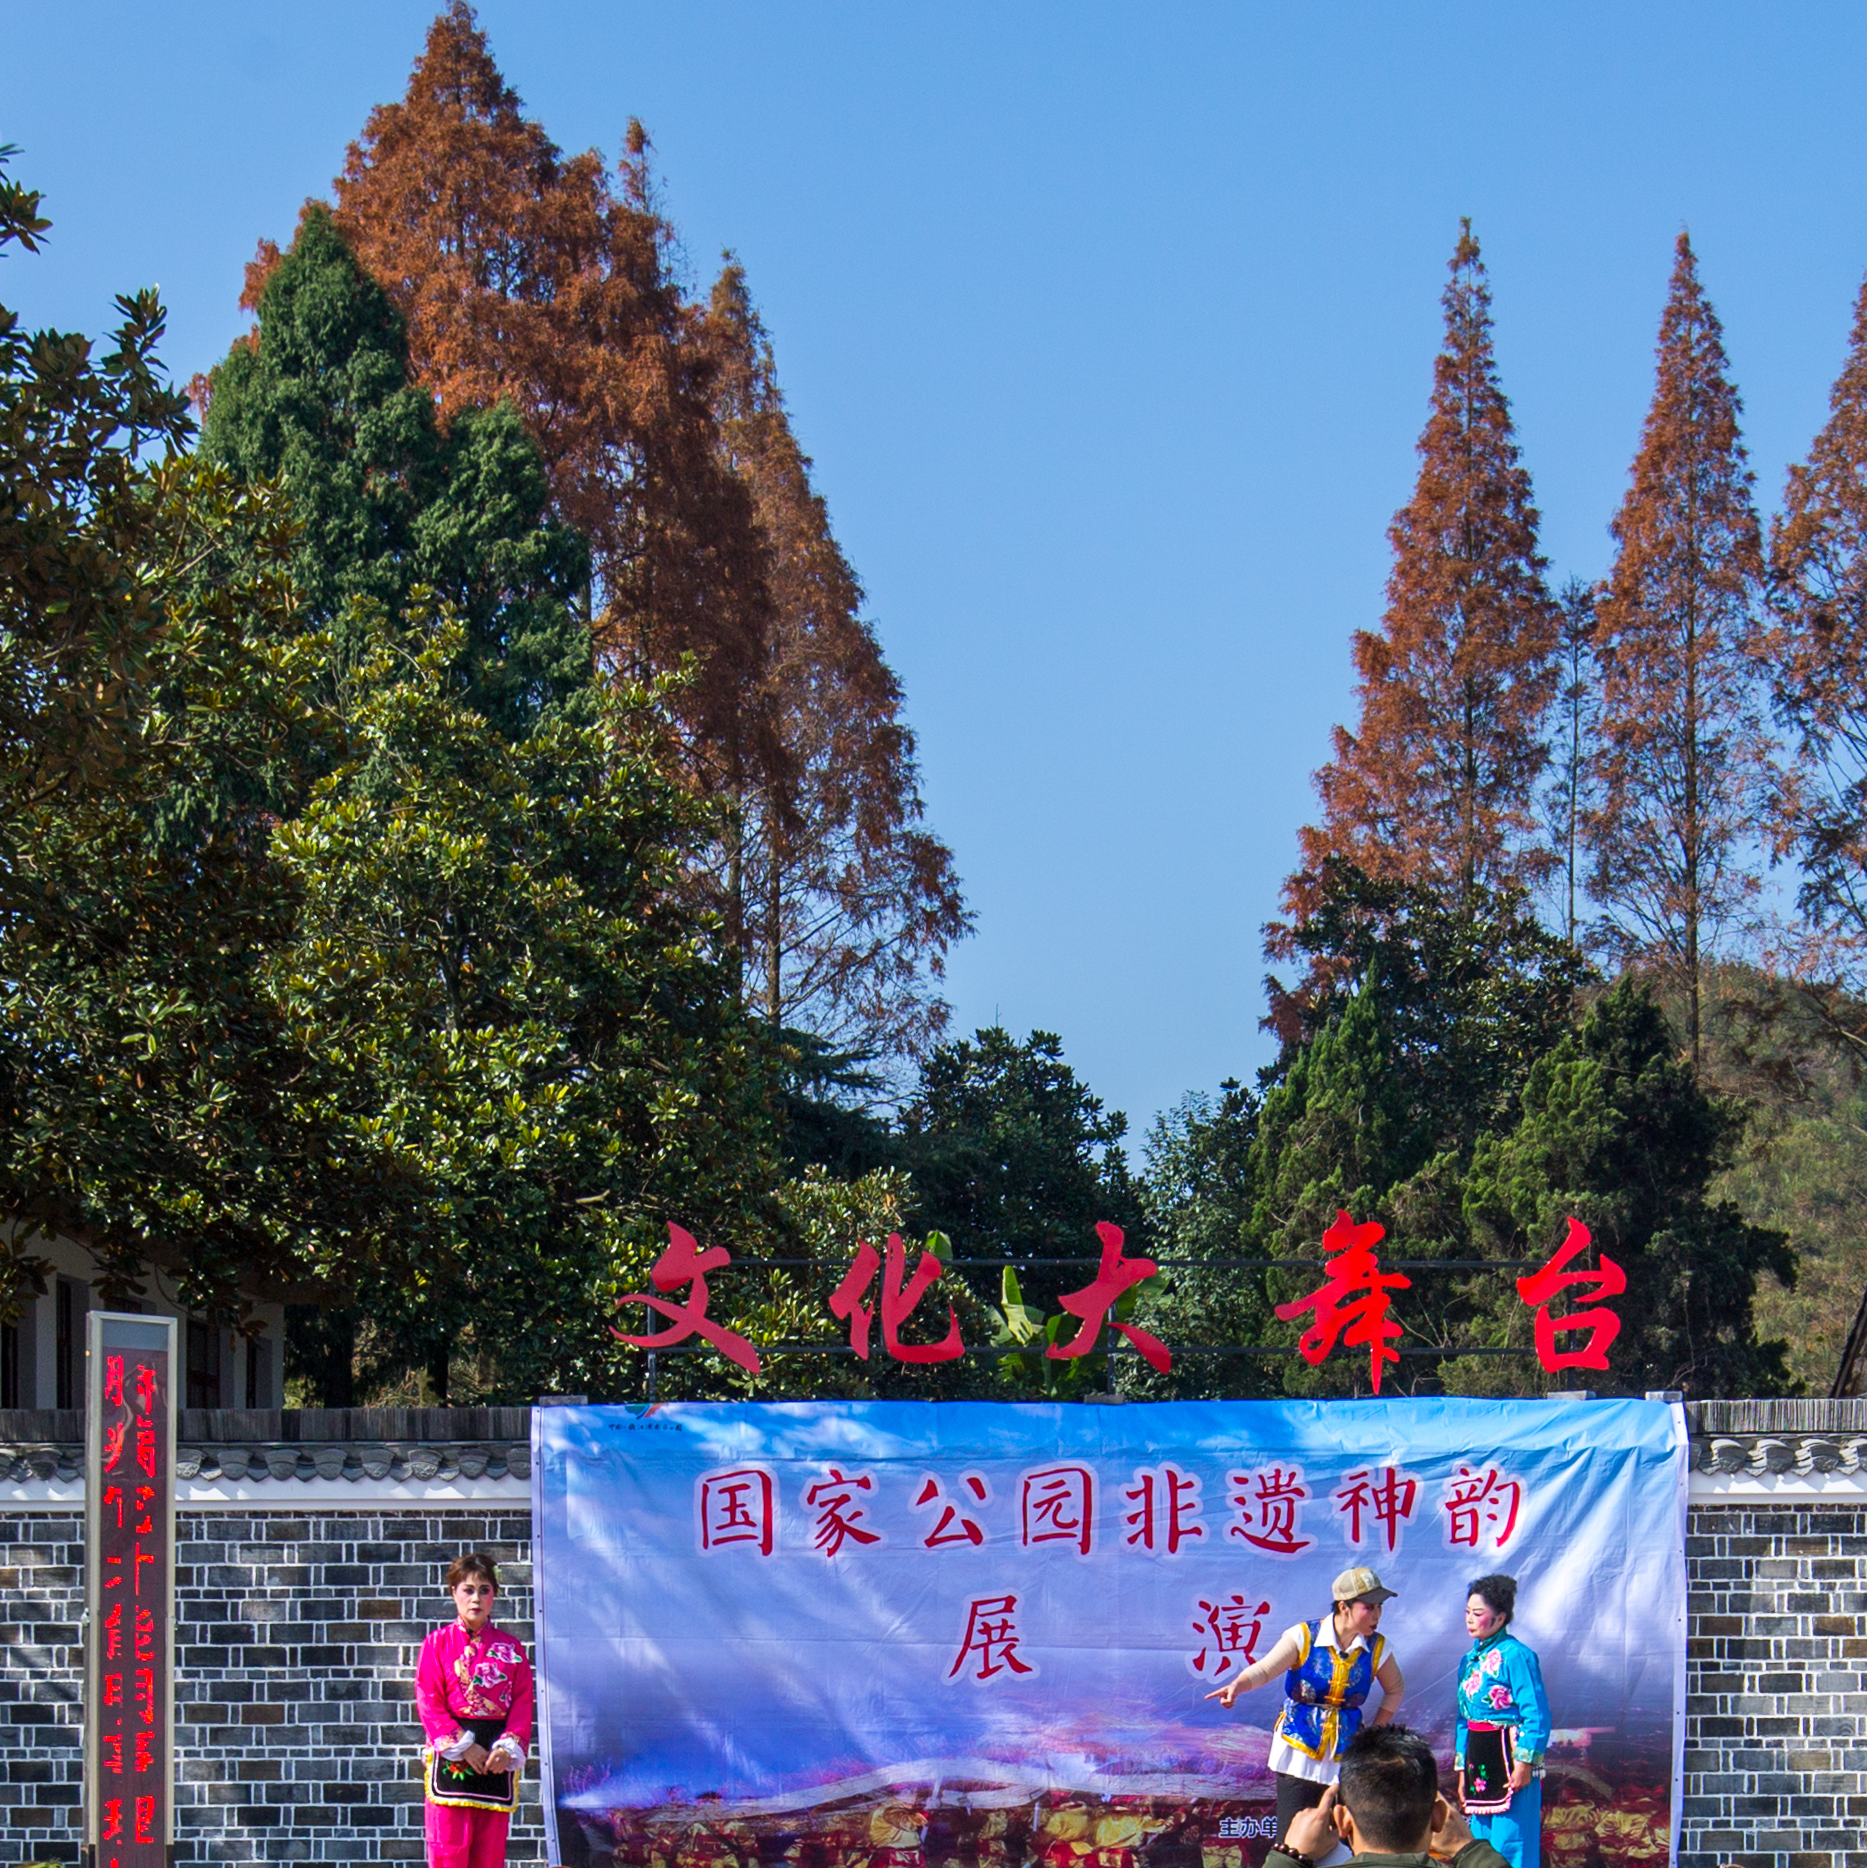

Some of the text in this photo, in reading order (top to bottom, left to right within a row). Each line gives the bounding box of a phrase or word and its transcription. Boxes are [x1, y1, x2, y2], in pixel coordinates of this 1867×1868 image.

[608, 1208, 1628, 1396] 文化大舞台
[701, 1466, 1521, 1557] 国家公园非遗神韵
[948, 1594, 1271, 1679] 展演
